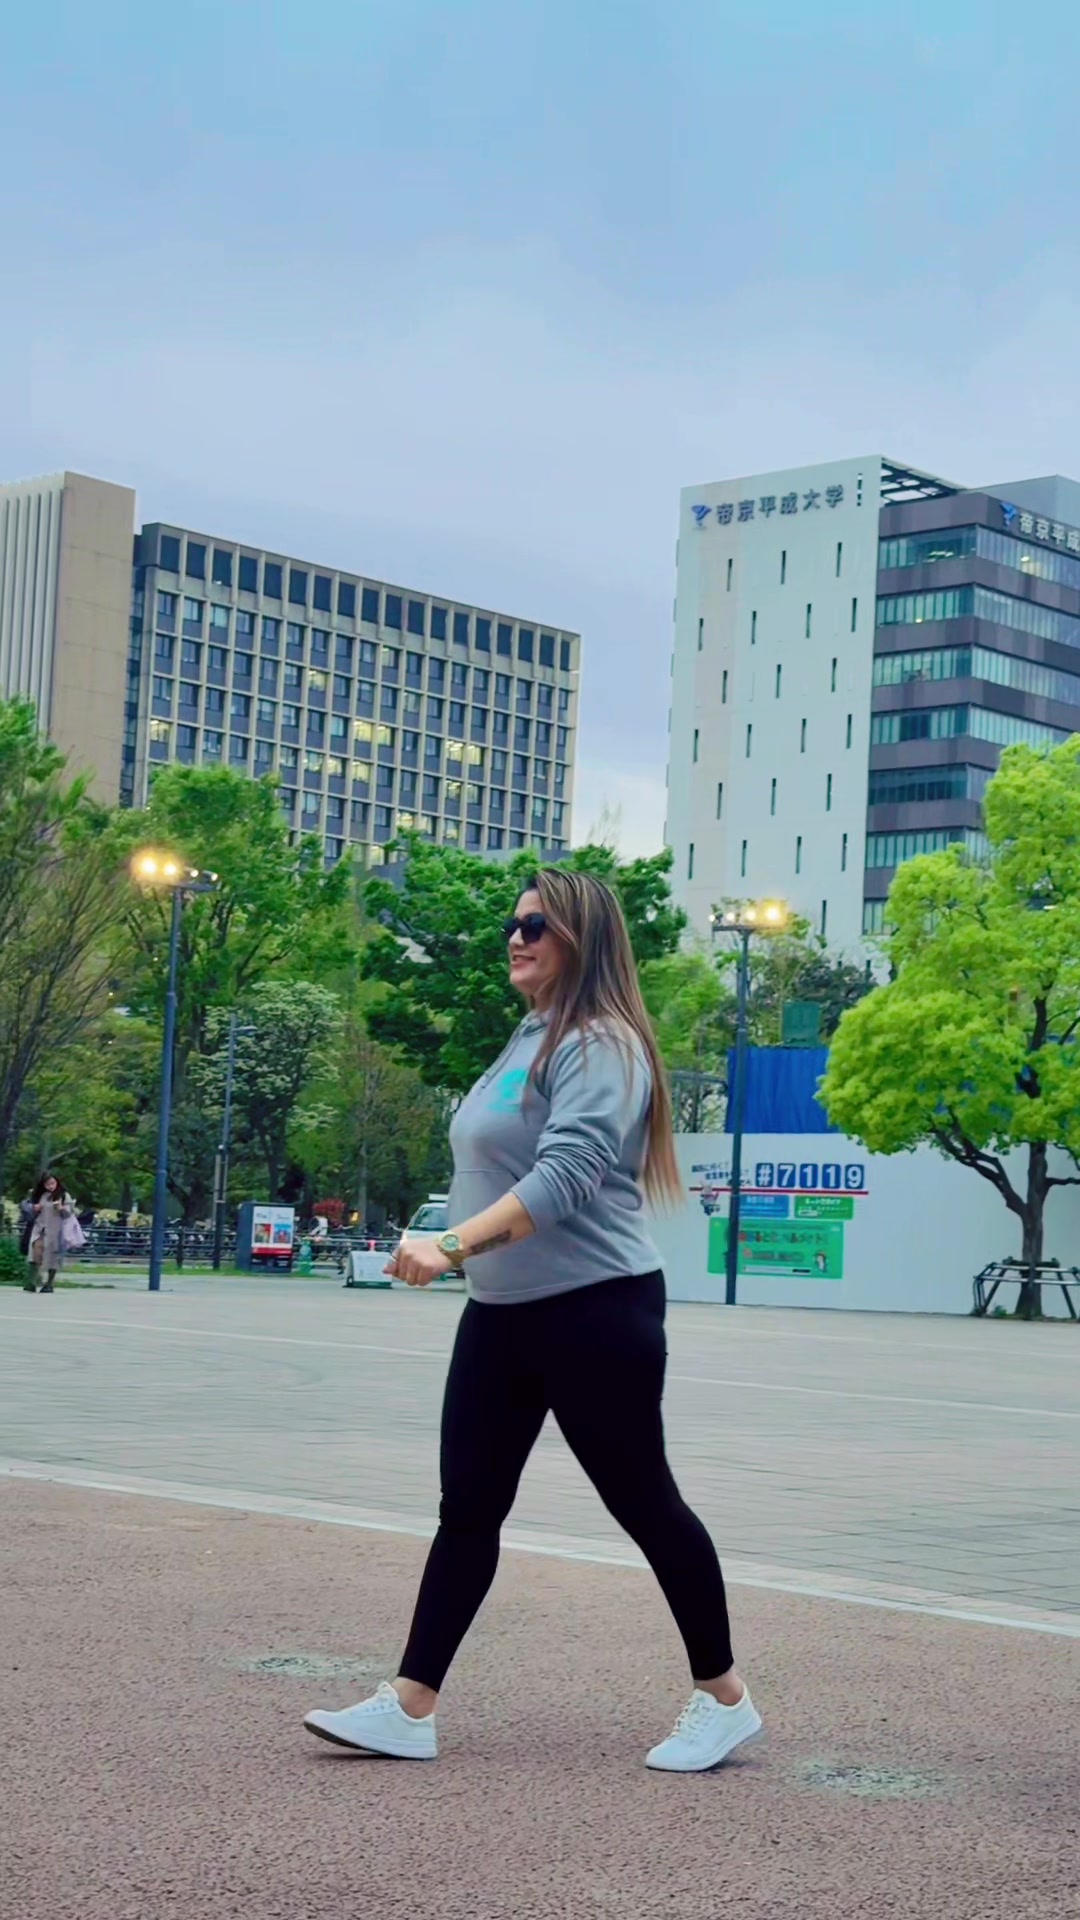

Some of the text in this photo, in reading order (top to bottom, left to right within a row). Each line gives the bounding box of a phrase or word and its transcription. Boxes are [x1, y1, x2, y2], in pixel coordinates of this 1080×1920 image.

[716, 485, 845, 525] 帝京平成大学
[757, 1164, 864, 1188] #7119
